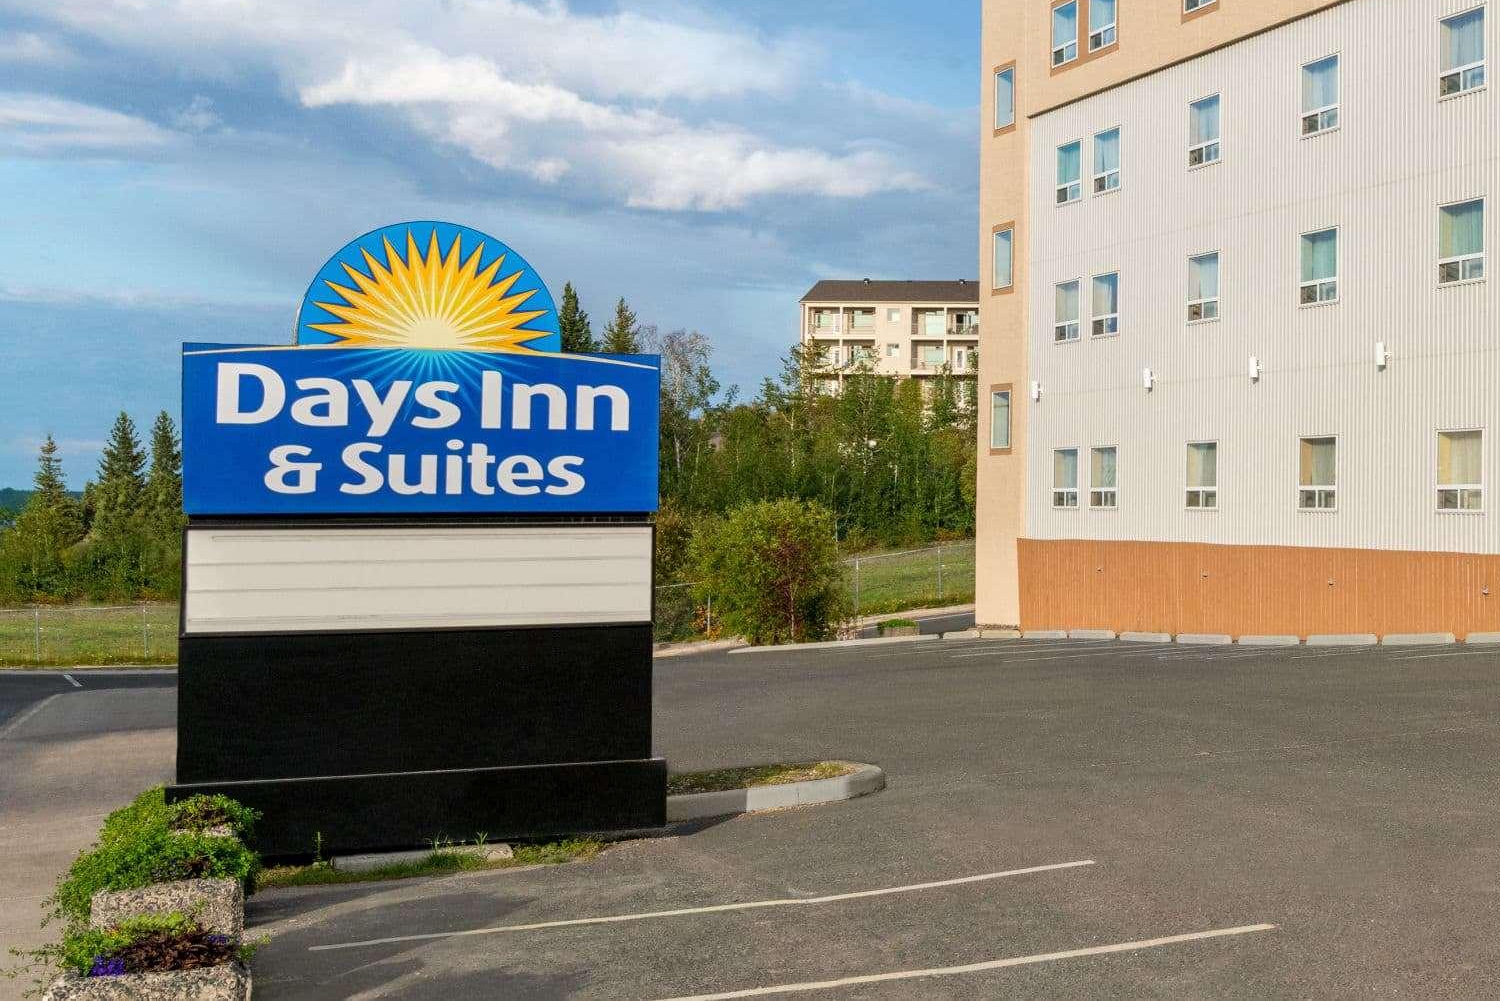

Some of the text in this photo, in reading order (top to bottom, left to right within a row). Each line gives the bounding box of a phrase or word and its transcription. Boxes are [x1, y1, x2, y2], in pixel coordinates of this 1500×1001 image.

[216, 362, 629, 437] Days Inn
[264, 439, 585, 496] & Suites
